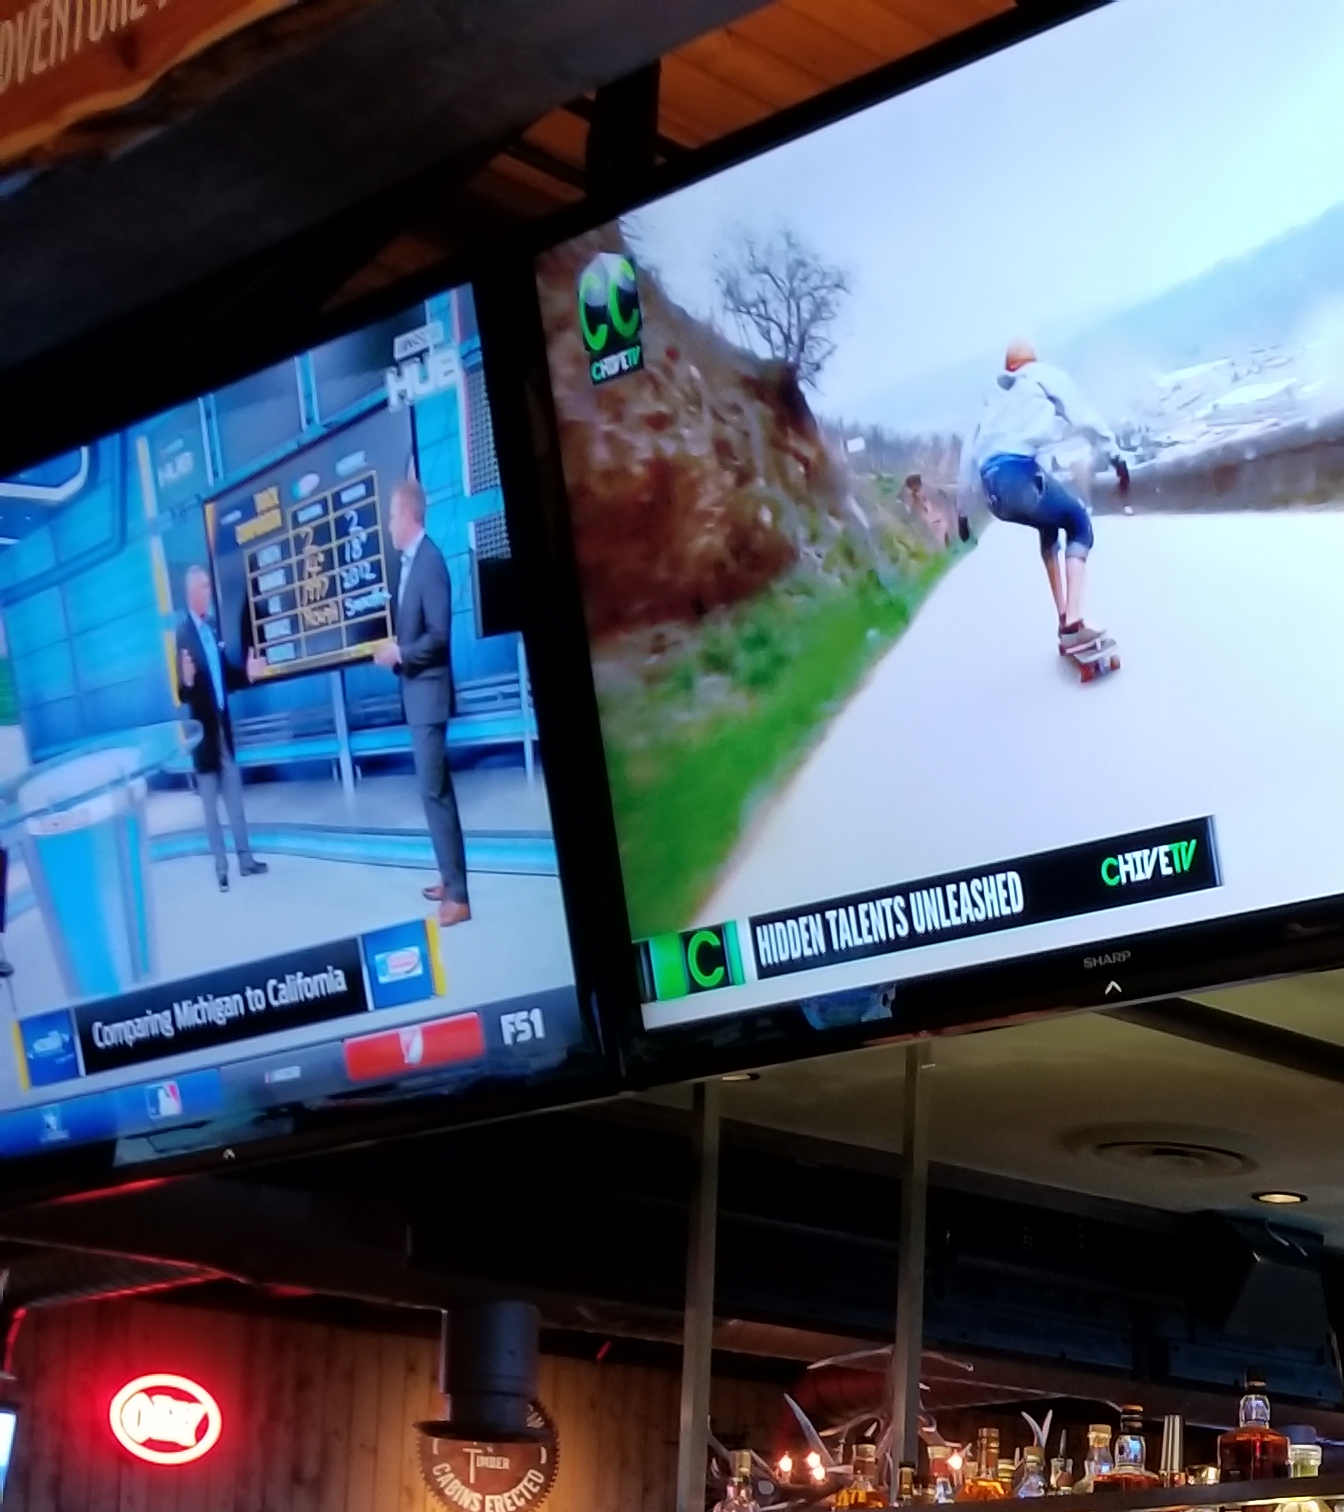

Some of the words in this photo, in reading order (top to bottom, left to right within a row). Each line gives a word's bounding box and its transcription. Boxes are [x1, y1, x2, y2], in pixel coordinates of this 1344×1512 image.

[386, 346, 463, 412] HUB
[1101, 839, 1197, 886] CHIVETV
[756, 913, 825, 967] HIDDEN
[825, 896, 909, 951] TALENTS
[909, 871, 1024, 933] UNLEASHED
[1083, 951, 1131, 968] SHARP
[92, 1009, 174, 1048] Comparing
[173, 993, 244, 1025] Michigan
[244, 985, 266, 1013] to
[266, 965, 347, 1008] California
[500, 1009, 546, 1045] FS1
[432, 1463, 482, 1512] CABINS
